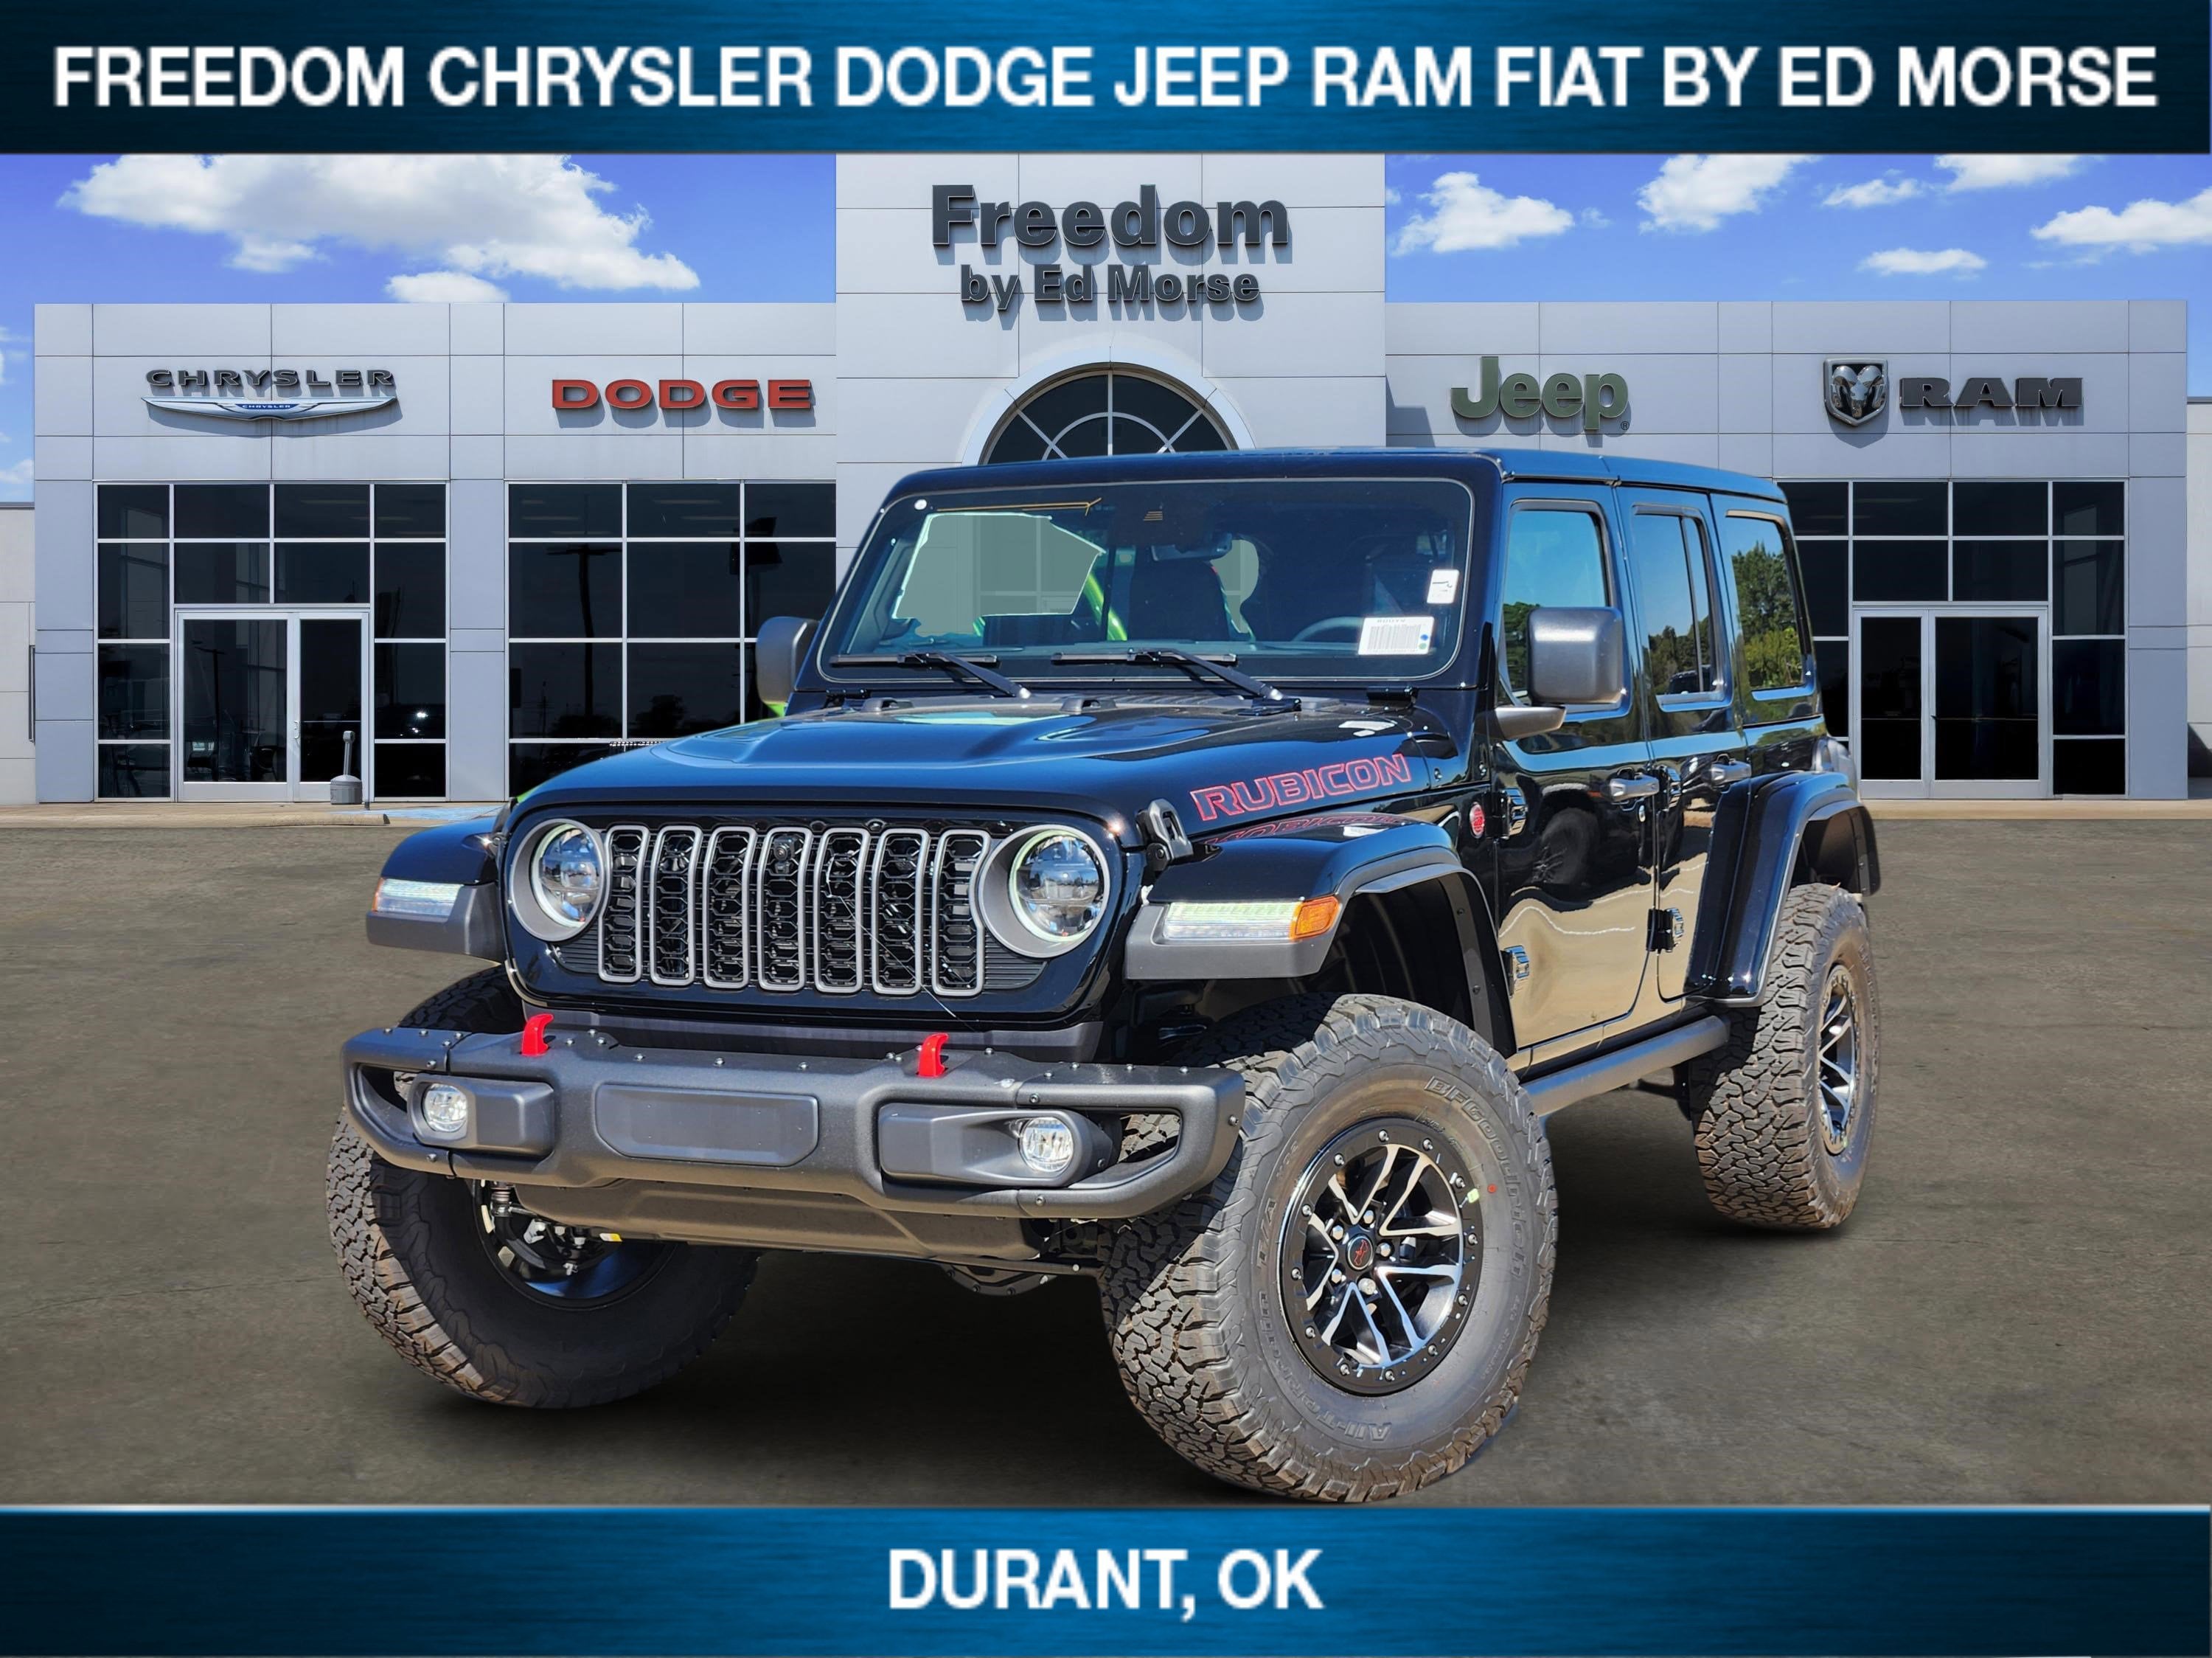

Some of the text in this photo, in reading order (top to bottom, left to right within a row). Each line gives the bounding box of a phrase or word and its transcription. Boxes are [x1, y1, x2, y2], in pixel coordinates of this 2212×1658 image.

[932, 184, 1289, 246] Freedom
[961, 263, 1261, 311] by Ed Morse
[145, 369, 394, 387] CHRYSLER
[552, 378, 812, 409] DODGE
[1450, 355, 1630, 430] Jeep
[1899, 377, 2084, 407] RAM
[1189, 752, 1411, 822] RUBICON
[1424, 1075, 1527, 1278] BFGoodrich
